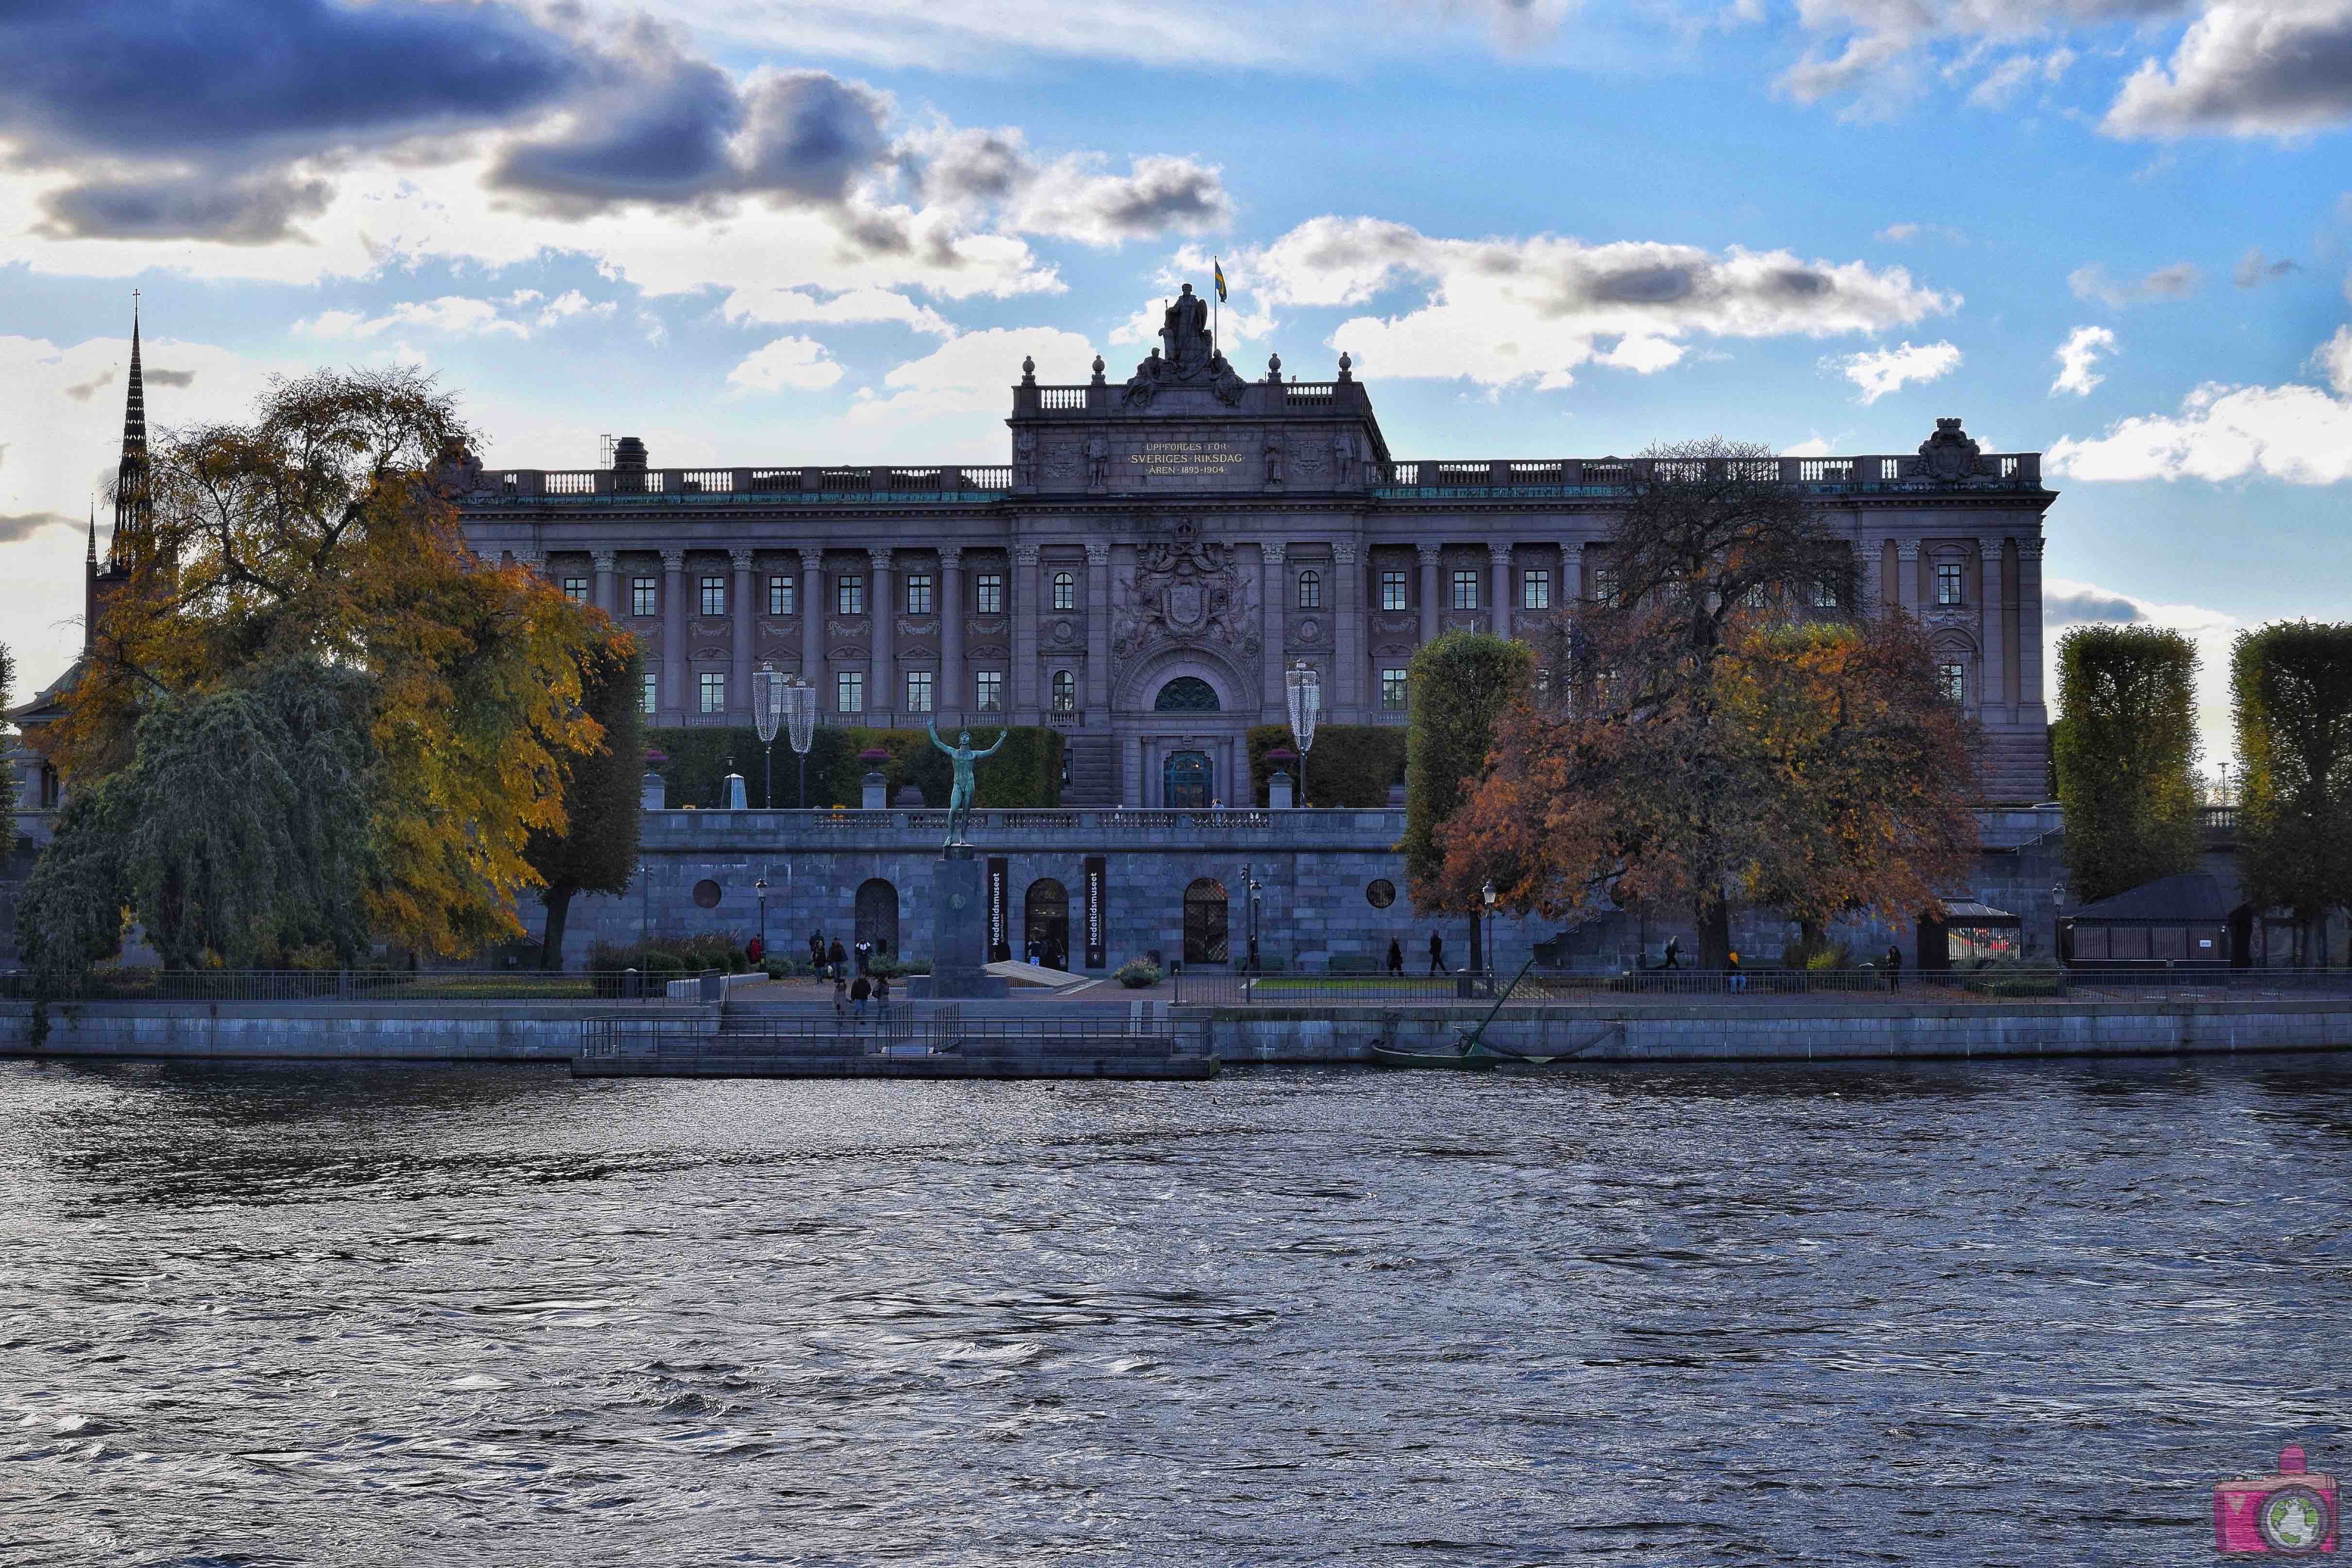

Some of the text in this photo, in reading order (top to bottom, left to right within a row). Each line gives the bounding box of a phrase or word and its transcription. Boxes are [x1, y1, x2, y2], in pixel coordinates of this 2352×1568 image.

[1131, 454, 1242, 463] SVERIGES RIKSDAG
[1149, 465, 1175, 474] ÅREN
